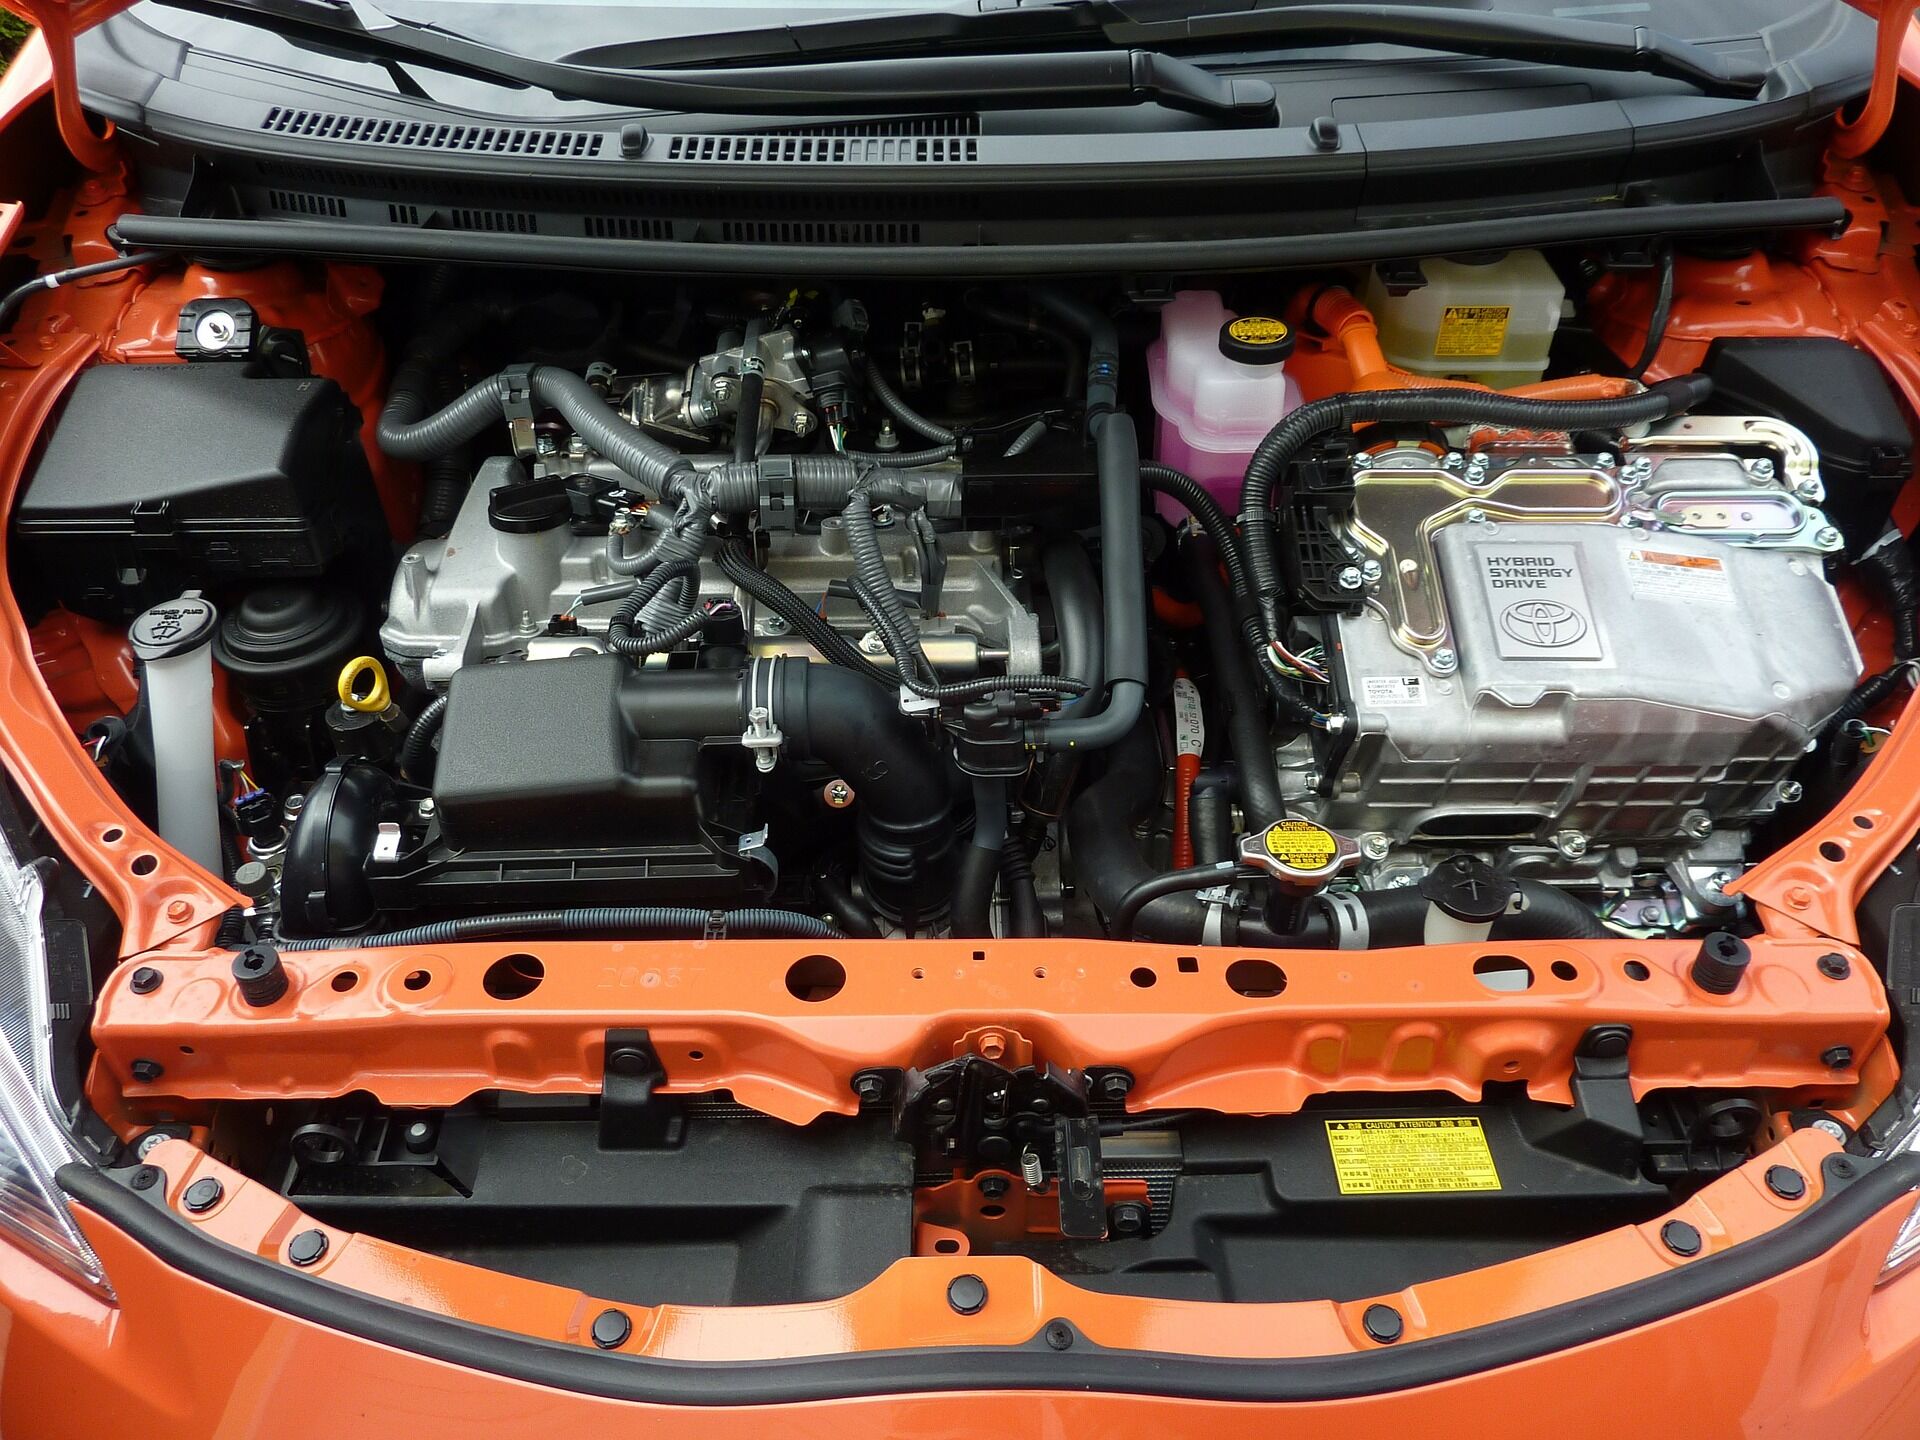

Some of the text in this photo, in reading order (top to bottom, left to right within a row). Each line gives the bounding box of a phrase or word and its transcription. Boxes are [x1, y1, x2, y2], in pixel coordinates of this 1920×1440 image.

[1486, 557, 1555, 566] HYBRID
[1489, 568, 1573, 577] SYNERGY
[1491, 579, 1548, 588] DRIVE
[1191, 739, 1202, 748] C
[1365, 1120, 1437, 1129] CAUTION ATTENTION
